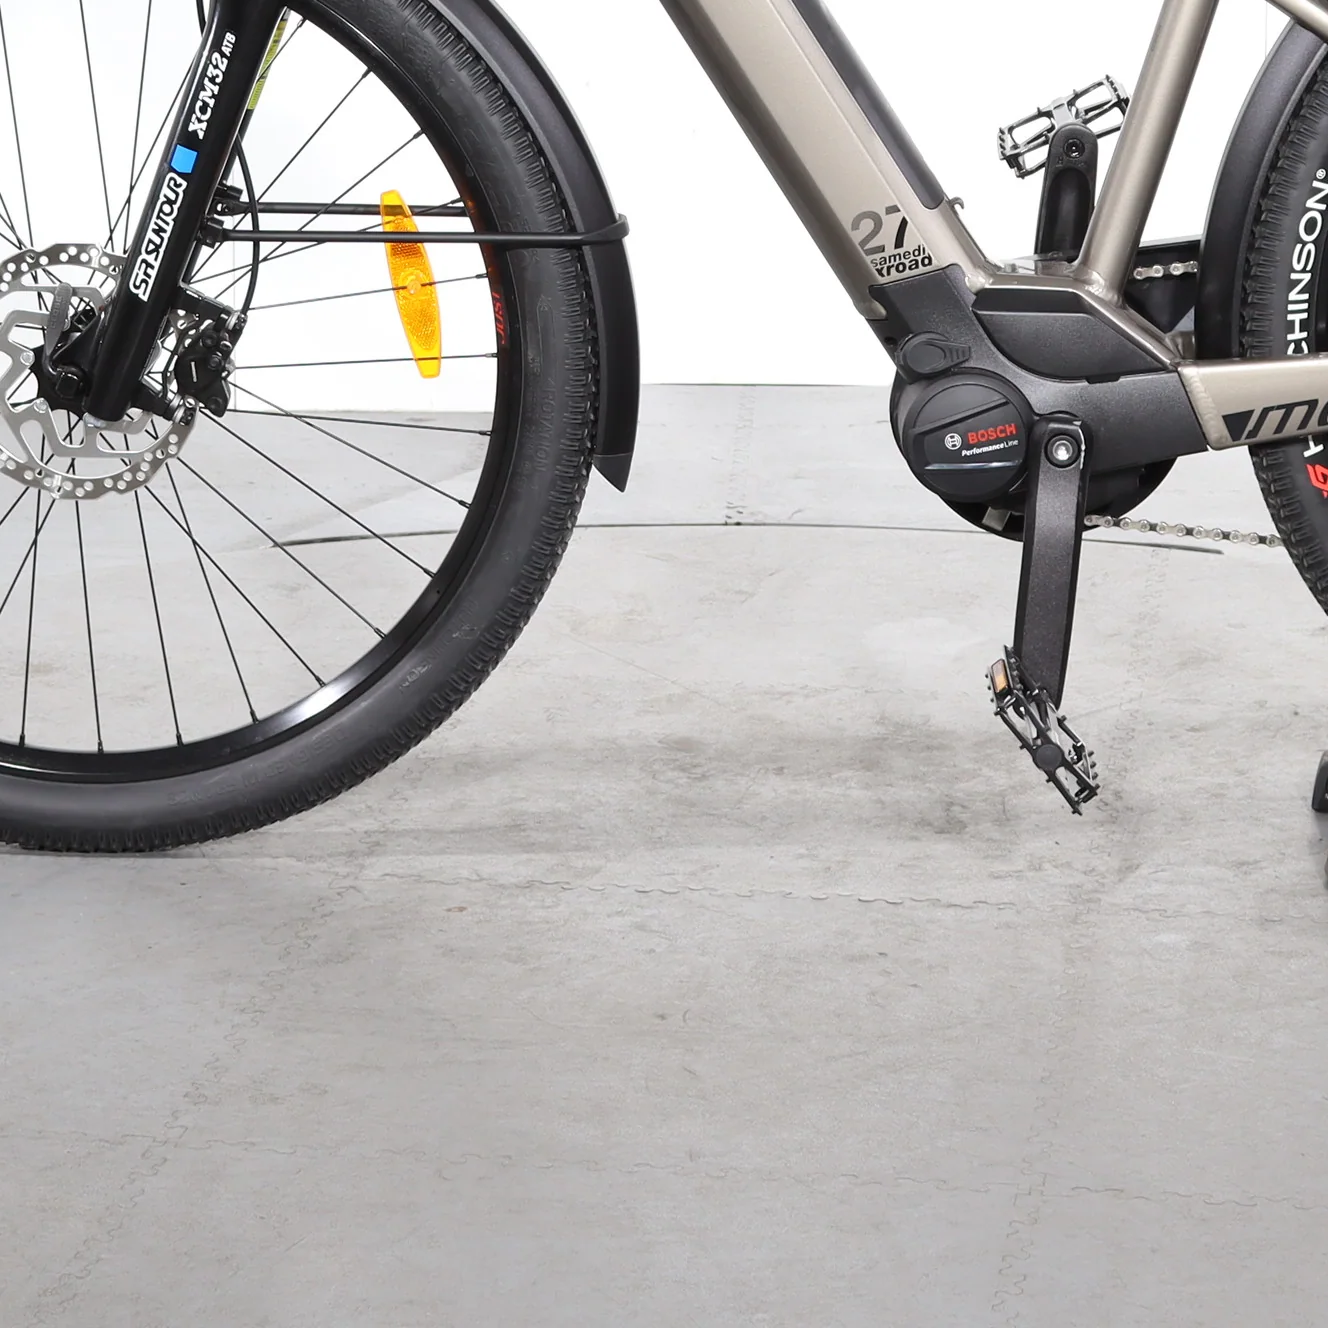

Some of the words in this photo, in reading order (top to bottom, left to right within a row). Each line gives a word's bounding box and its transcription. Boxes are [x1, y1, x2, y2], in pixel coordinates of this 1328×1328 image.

[188, 51, 227, 140] XCM32
[220, 30, 237, 58] ATB
[142, 173, 188, 260] SUNTOUR
[851, 204, 909, 257] 27
[130, 252, 158, 302] SR
[870, 243, 926, 268] samedi
[968, 423, 1017, 445] BOSCH
